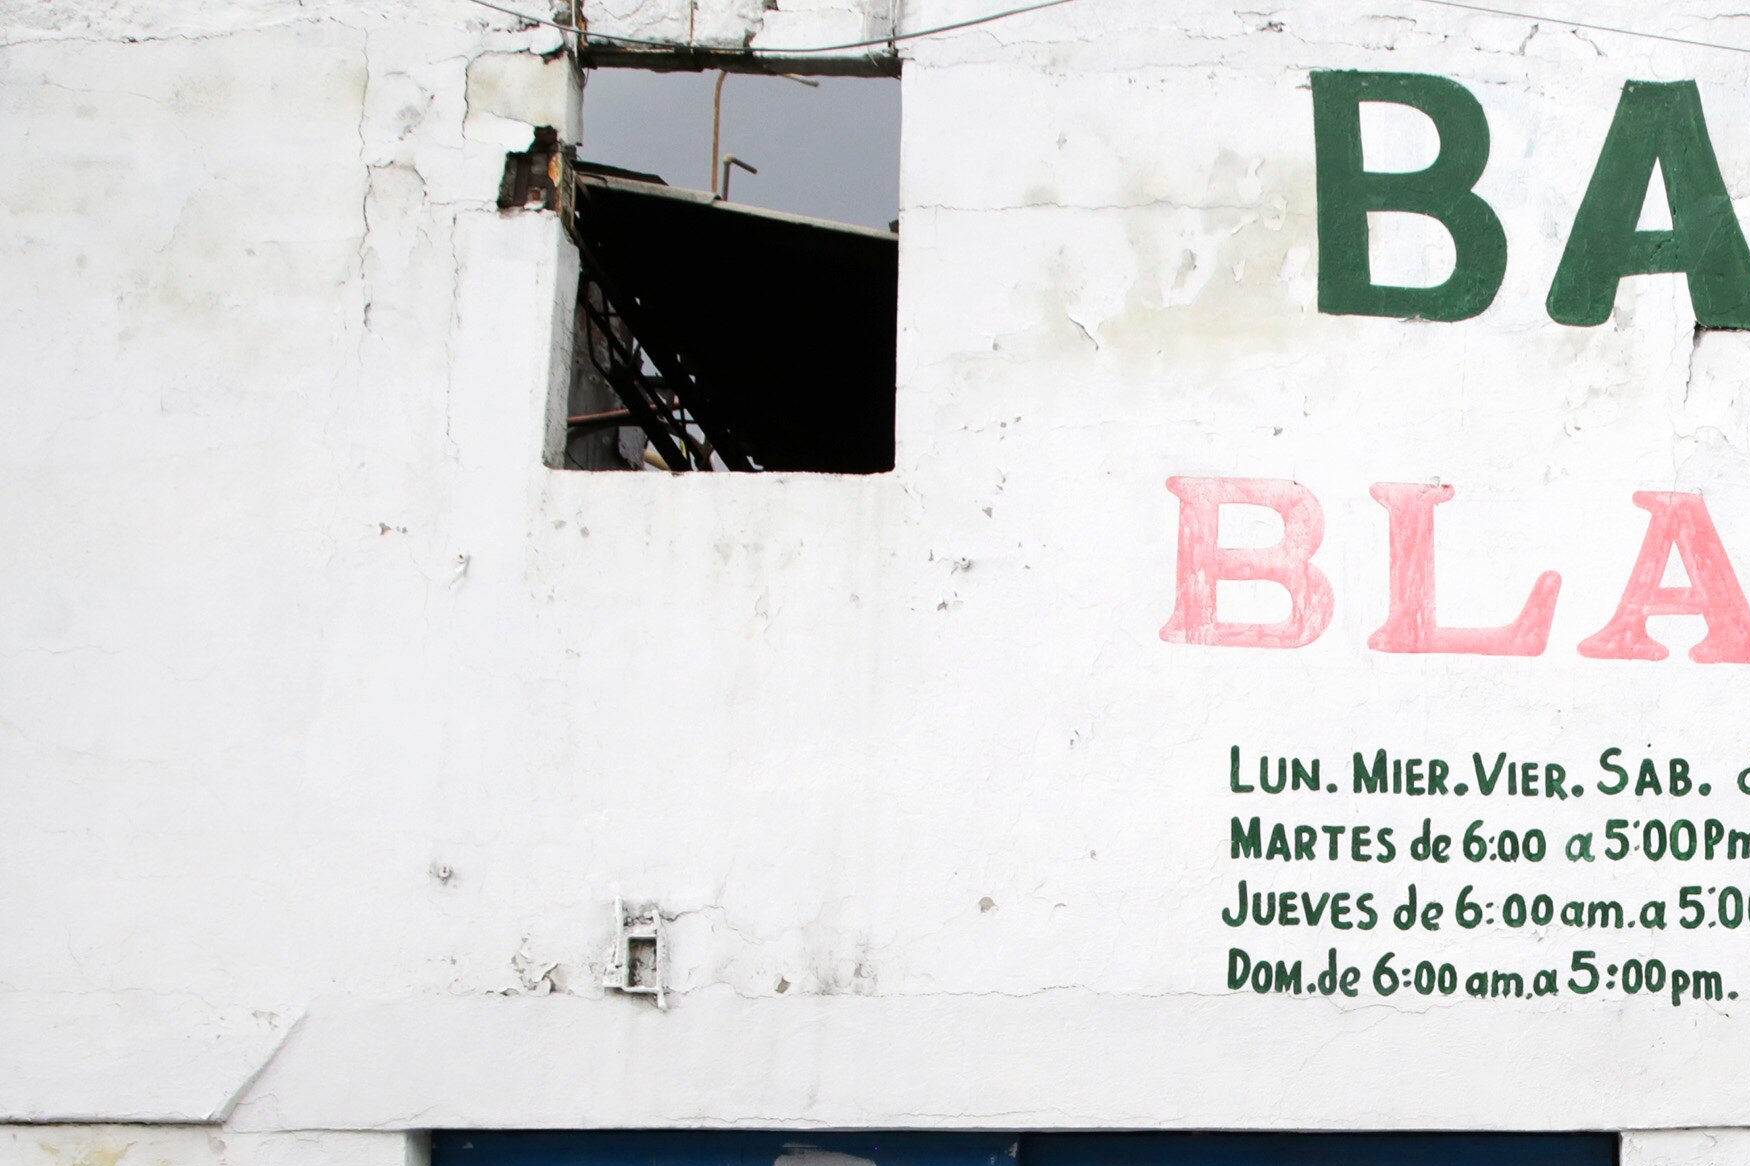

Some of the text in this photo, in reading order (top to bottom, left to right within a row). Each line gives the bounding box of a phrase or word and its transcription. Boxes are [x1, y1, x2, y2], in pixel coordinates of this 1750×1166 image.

[1229, 745, 1338, 794] LUN.
[1597, 747, 1711, 796] SAB.
[1229, 816, 1397, 862] MARTES
[1409, 817, 1450, 862] de
[1462, 818, 1547, 862] 6:00
[1564, 831, 1596, 863] a
[1221, 879, 1378, 929] JUEVES
[1393, 882, 1441, 930] de
